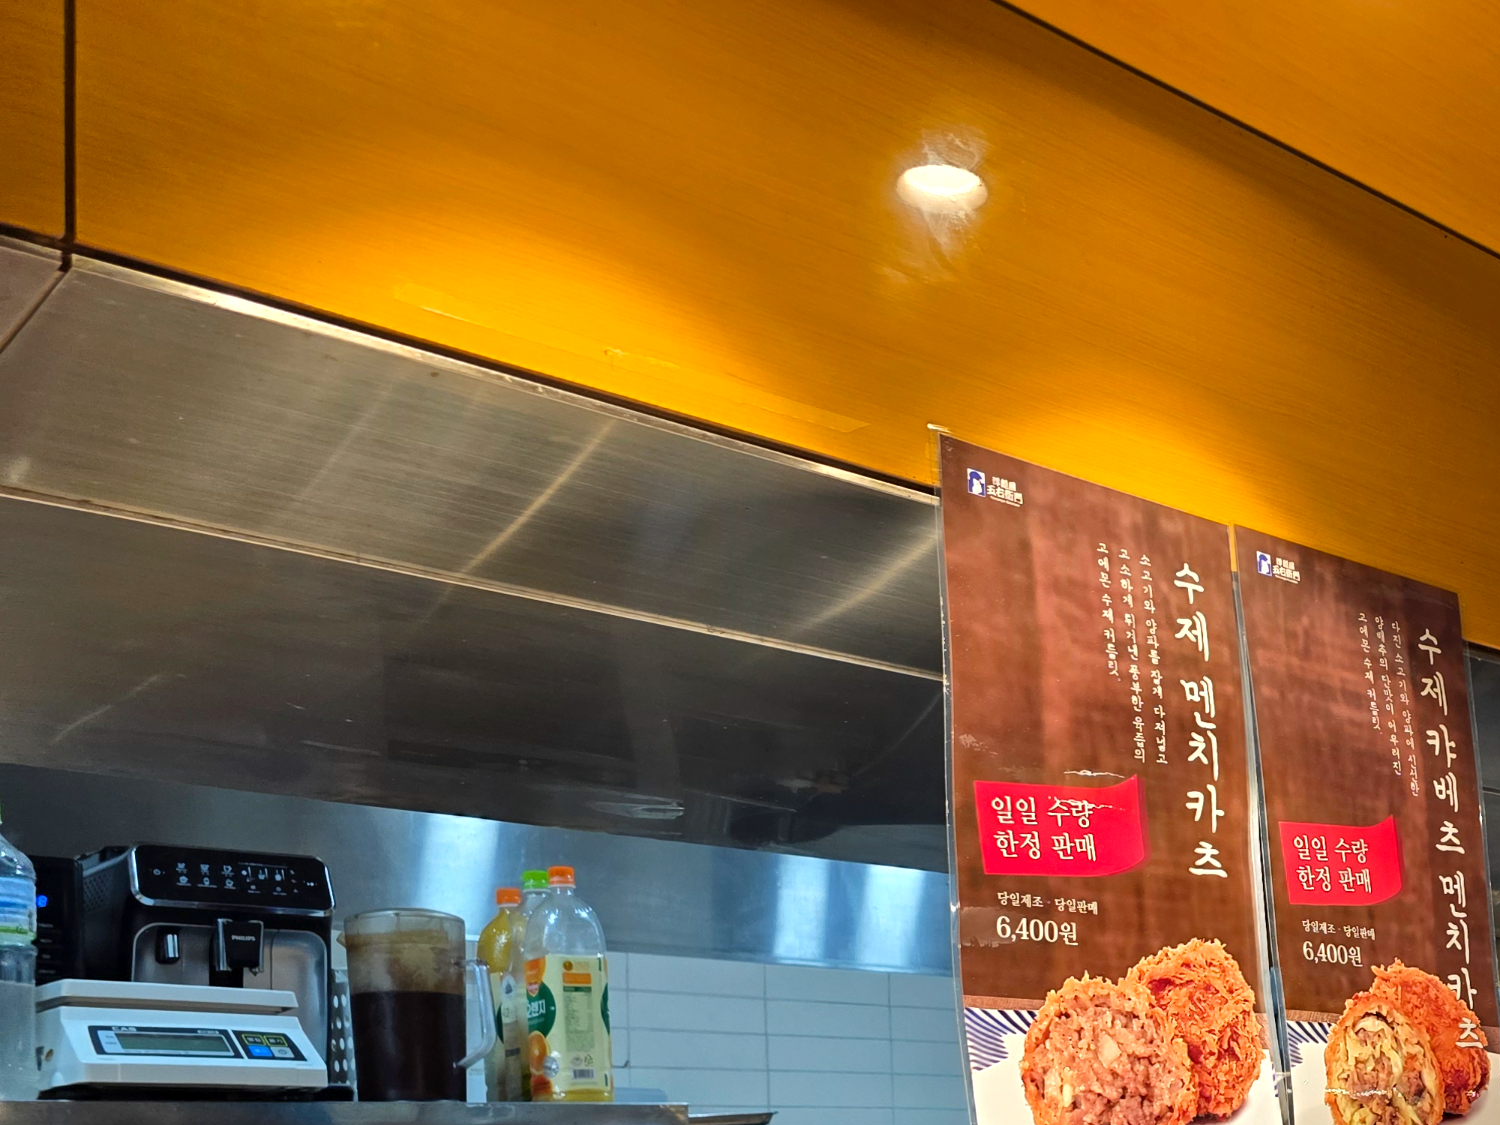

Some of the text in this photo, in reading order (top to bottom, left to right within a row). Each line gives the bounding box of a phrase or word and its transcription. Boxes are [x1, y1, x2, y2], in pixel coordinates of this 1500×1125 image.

[1096, 542, 1112, 589] 고에몬
[1139, 554, 1156, 614] 소고기와
[1101, 593, 1114, 624] 수제
[1118, 548, 1134, 609] 고소하게
[1128, 664, 1145, 712] 풍부한
[1363, 657, 1374, 685] 수제
[1173, 562, 1228, 878] 수제 멘치카츠
[991, 795, 1094, 828] 일일 수량
[993, 830, 1097, 862] 한정 판매
[1293, 835, 1369, 864] 일일 수량
[1418, 628, 1448, 716] 수제
[1438, 870, 1484, 1049] 멘치카츠
[1296, 865, 1372, 894] 한정 판매
[996, 891, 1099, 915] 당일제조 당일판매
[996, 915, 1079, 946] 6,400원
[1302, 919, 1376, 941] 당일제조 당일판매
[1302, 941, 1363, 967] 6,400원
